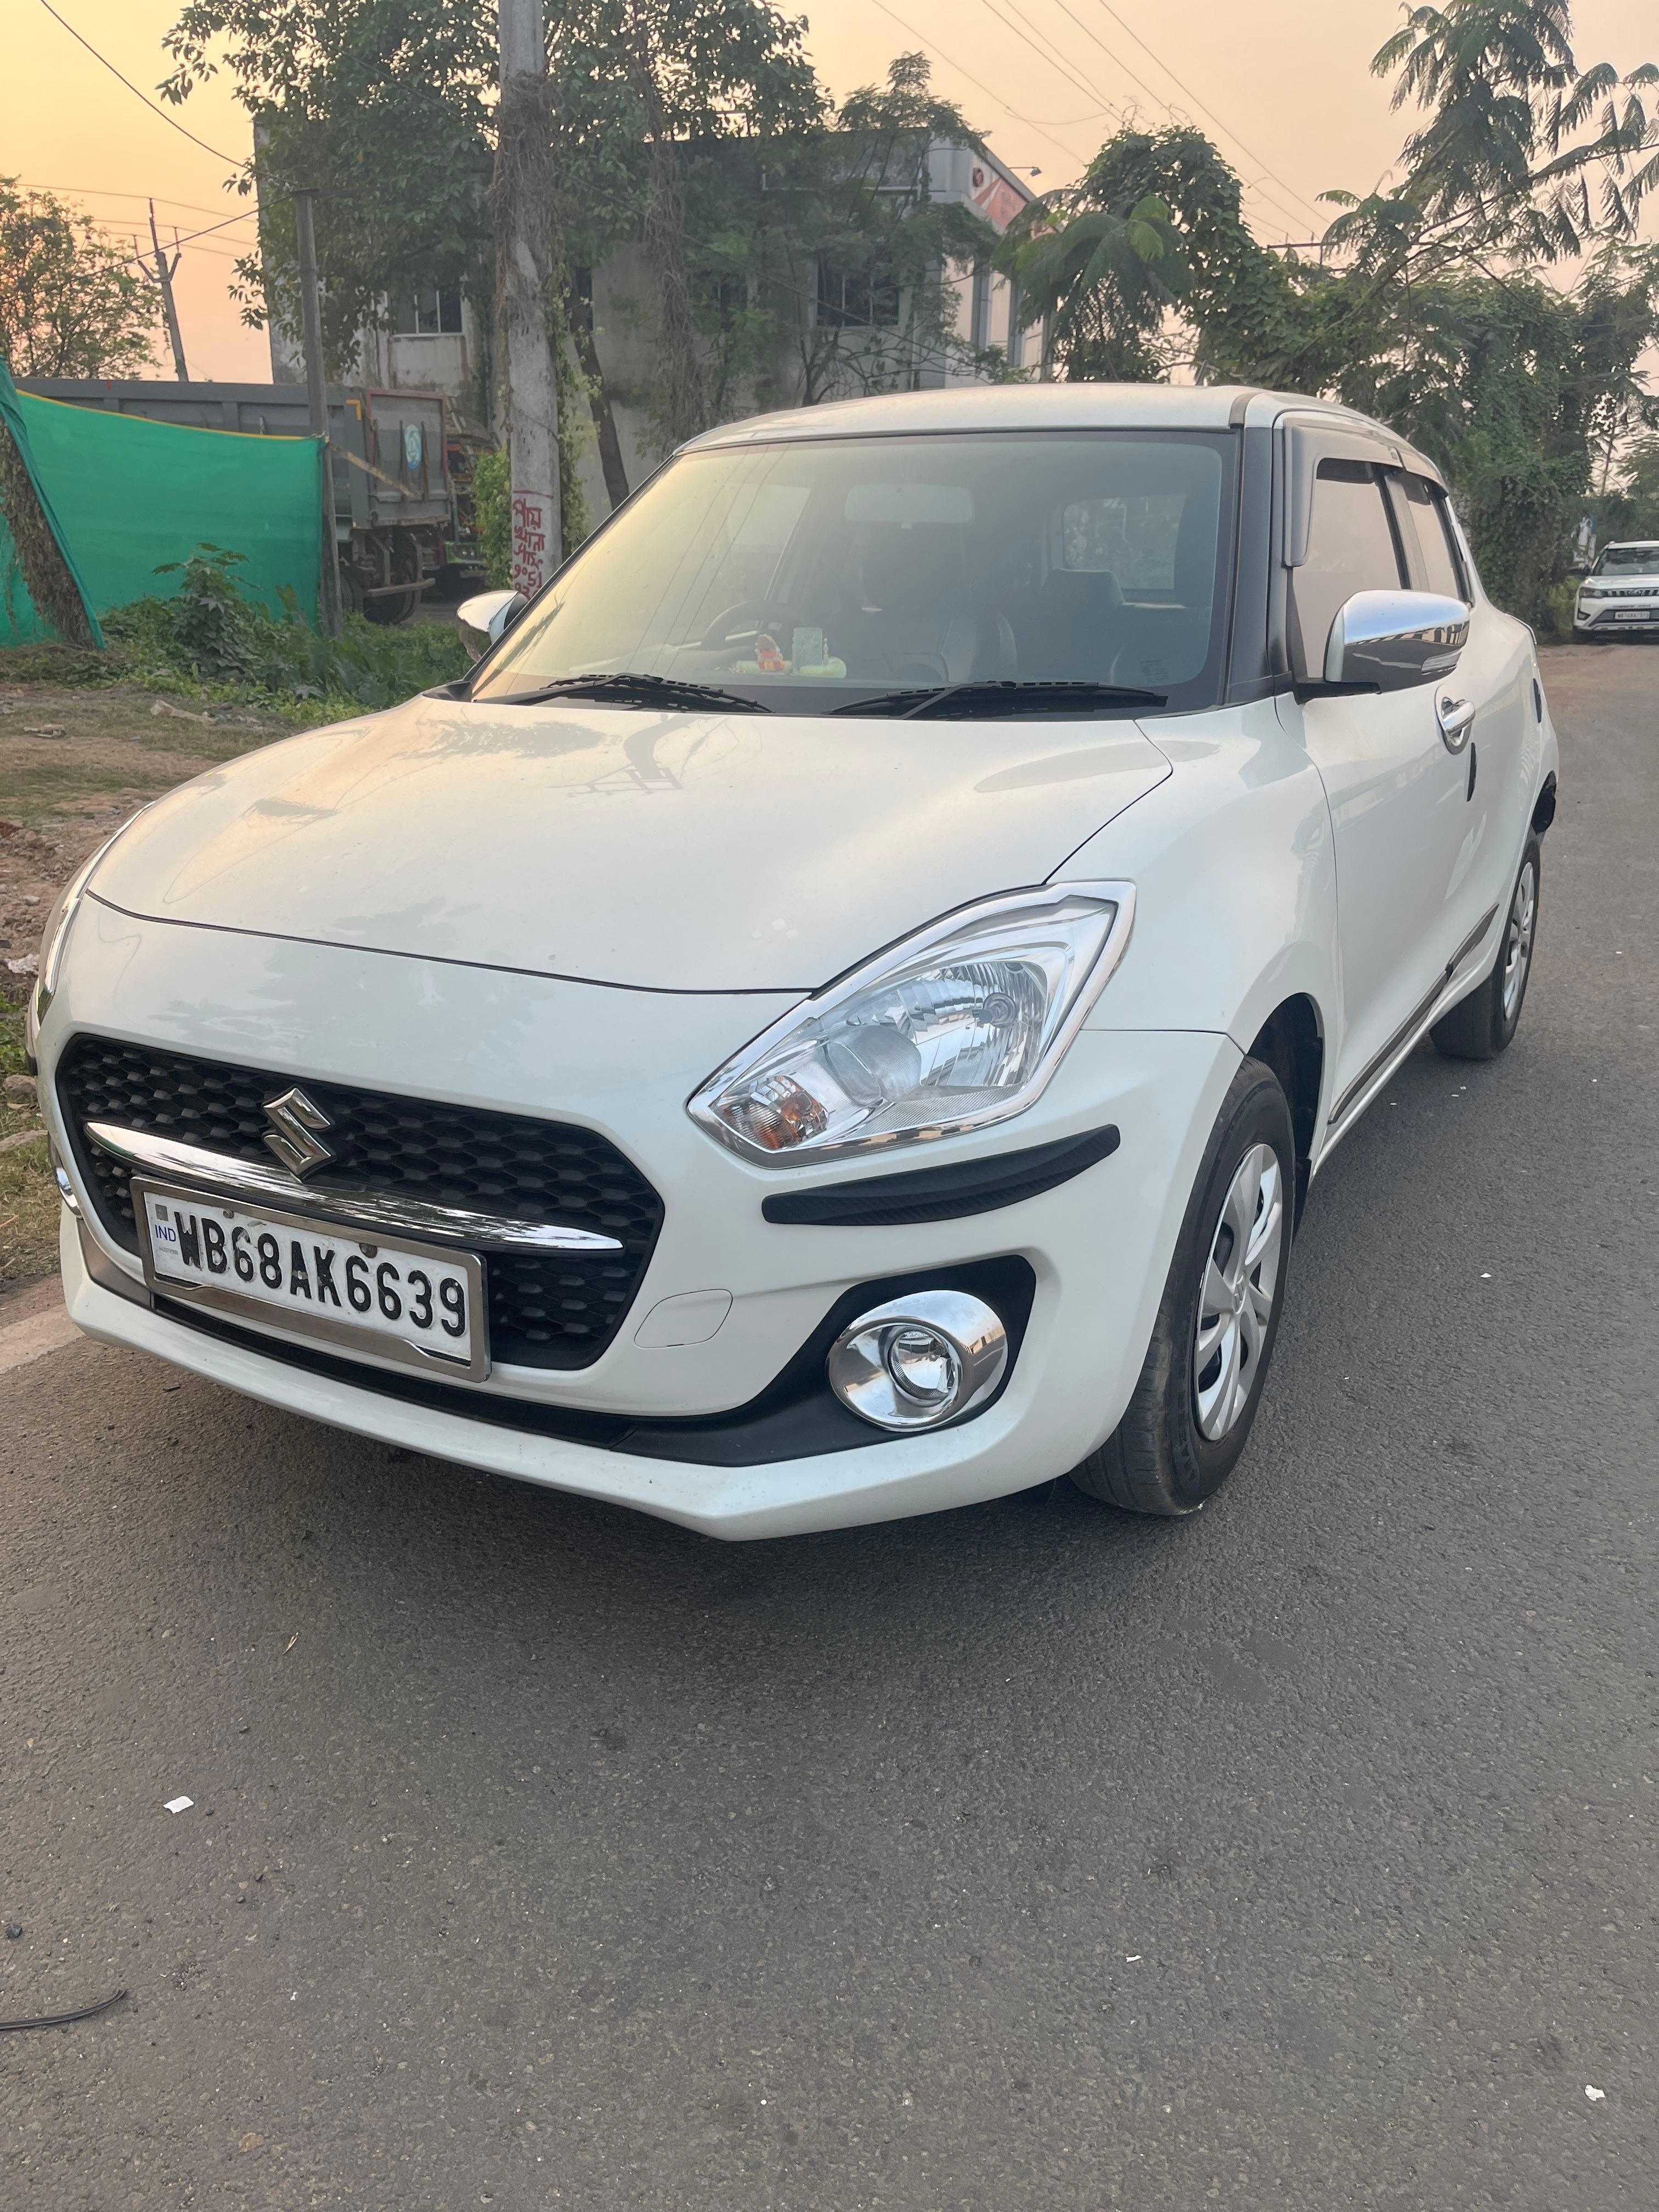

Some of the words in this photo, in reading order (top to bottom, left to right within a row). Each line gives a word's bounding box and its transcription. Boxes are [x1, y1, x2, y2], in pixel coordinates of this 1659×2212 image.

[511, 564, 542, 589] 9051
[155, 1224, 176, 1242] IND
[174, 1211, 466, 1338] WB68AK6639
